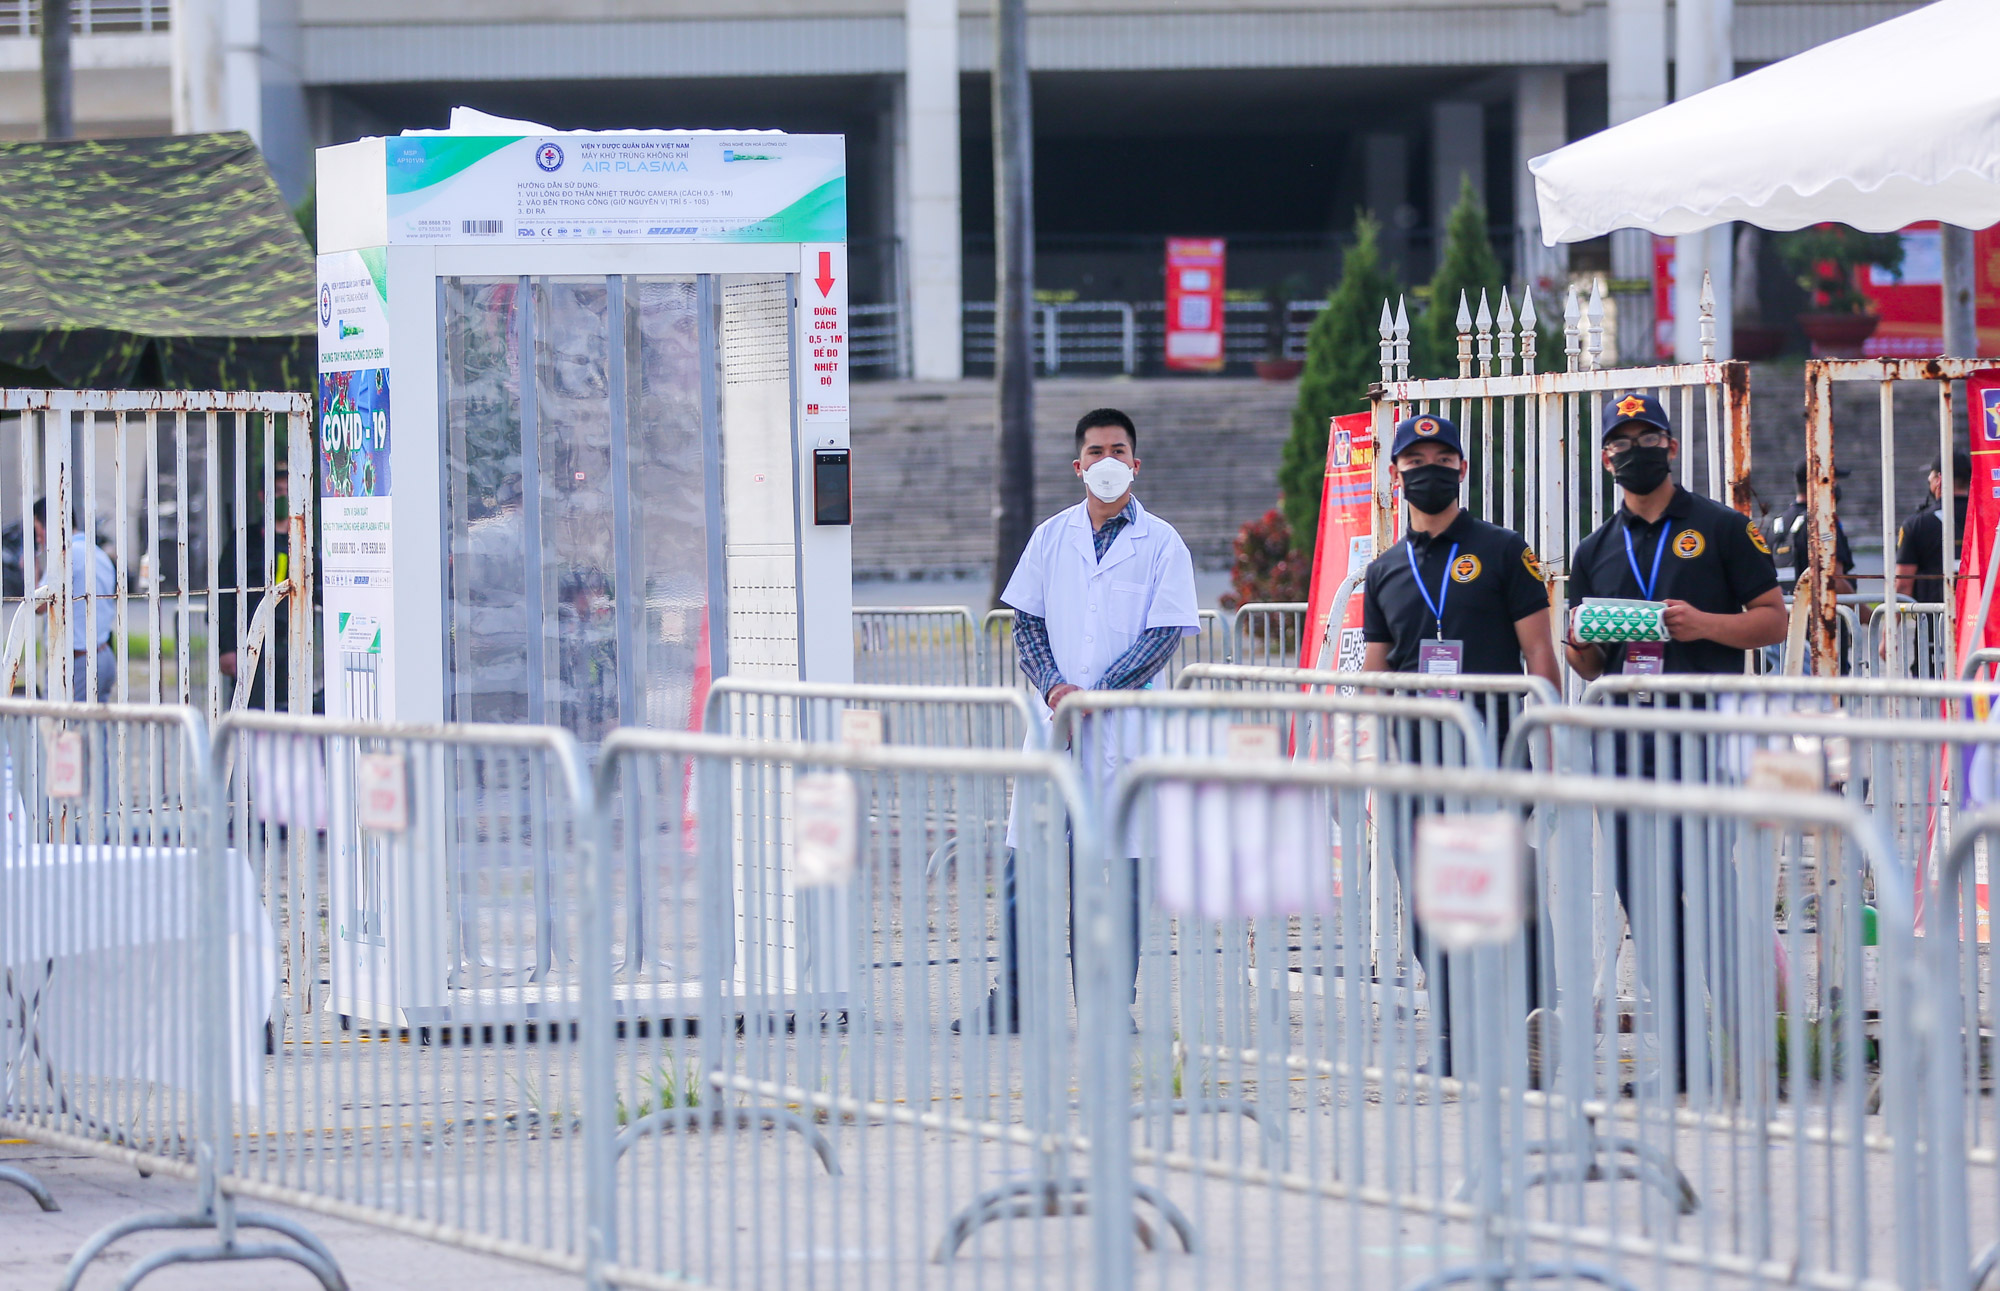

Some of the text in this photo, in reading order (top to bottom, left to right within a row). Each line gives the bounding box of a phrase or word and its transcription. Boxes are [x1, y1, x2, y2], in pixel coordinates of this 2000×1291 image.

[582, 151, 689, 159] MÁY KHỬ TRÙNG KHÔNG KHÍ
[582, 161, 688, 172] AIR PLASMA
[547, 181, 562, 189] DẪN
[565, 181, 575, 189] SỬ
[577, 182, 600, 190] DỤNG:
[596, 190, 617, 198] NHIỆT
[620, 189, 645, 197] TRƯỚC
[679, 189, 702, 198] (CÁCH
[721, 190, 733, 198] 1M)
[543, 198, 558, 206] BÊN
[629, 198, 658, 206] NGUYÊN
[518, 228, 535, 236] FDA
[814, 305, 837, 316] ĐỨNG
[814, 320, 837, 330] CÁCH
[809, 335, 822, 344] 0,5
[830, 335, 843, 343] 1M
[814, 345, 838, 357] ĐỂ ĐO
[321, 353, 333, 363] CHUNG
[814, 361, 838, 373] NHIỆT
[821, 375, 832, 387] ĐỘ
[322, 411, 363, 452] COVID
[372, 410, 386, 450] 19
